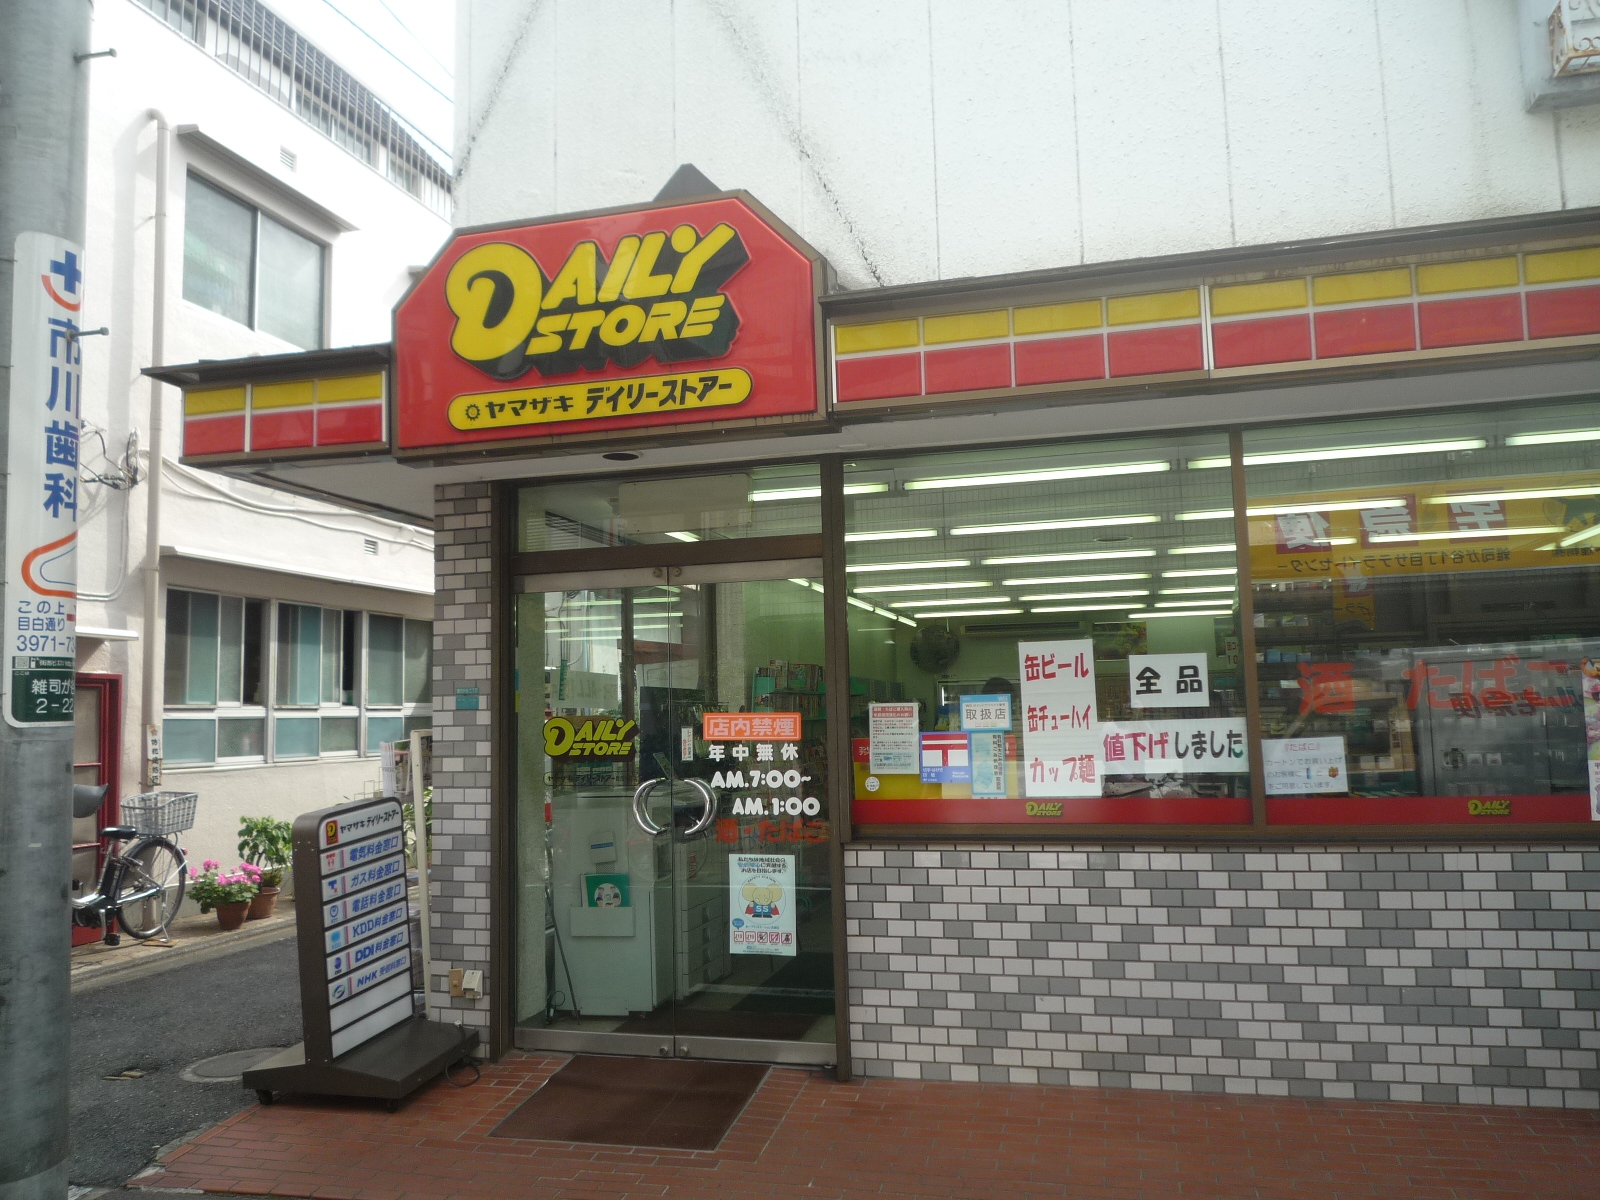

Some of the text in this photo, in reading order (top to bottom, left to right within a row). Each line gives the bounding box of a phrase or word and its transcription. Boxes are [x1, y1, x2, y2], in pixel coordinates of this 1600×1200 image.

[445, 222, 738, 362] DAILY
[525, 294, 726, 356] STORE
[485, 376, 732, 419] ヤマザキ デイリーストアー
[43, 317, 82, 523] 市川歯科
[18, 600, 65, 615] この上
[18, 617, 65, 632] 目白通り
[1024, 653, 1090, 682] 缶ビール
[1135, 665, 1204, 695] 全品
[1403, 653, 1574, 711] たばこ
[1297, 662, 1354, 714] 酒
[708, 717, 795, 737] 店内禁煙
[965, 708, 1006, 721] 取扱店
[1027, 704, 1092, 733] 缶チューハイ
[542, 716, 636, 757] DAILY
[568, 741, 633, 756] STORE
[1102, 730, 1245, 762] 値下げしました
[708, 742, 799, 762] 年中無休
[1029, 754, 1096, 783] カップ麺
[350, 859, 400, 888] ガス料金窓口
[352, 883, 402, 913] 電話料金窓口
[755, 905, 769, 913] SS
[356, 969, 378, 988] NHK
